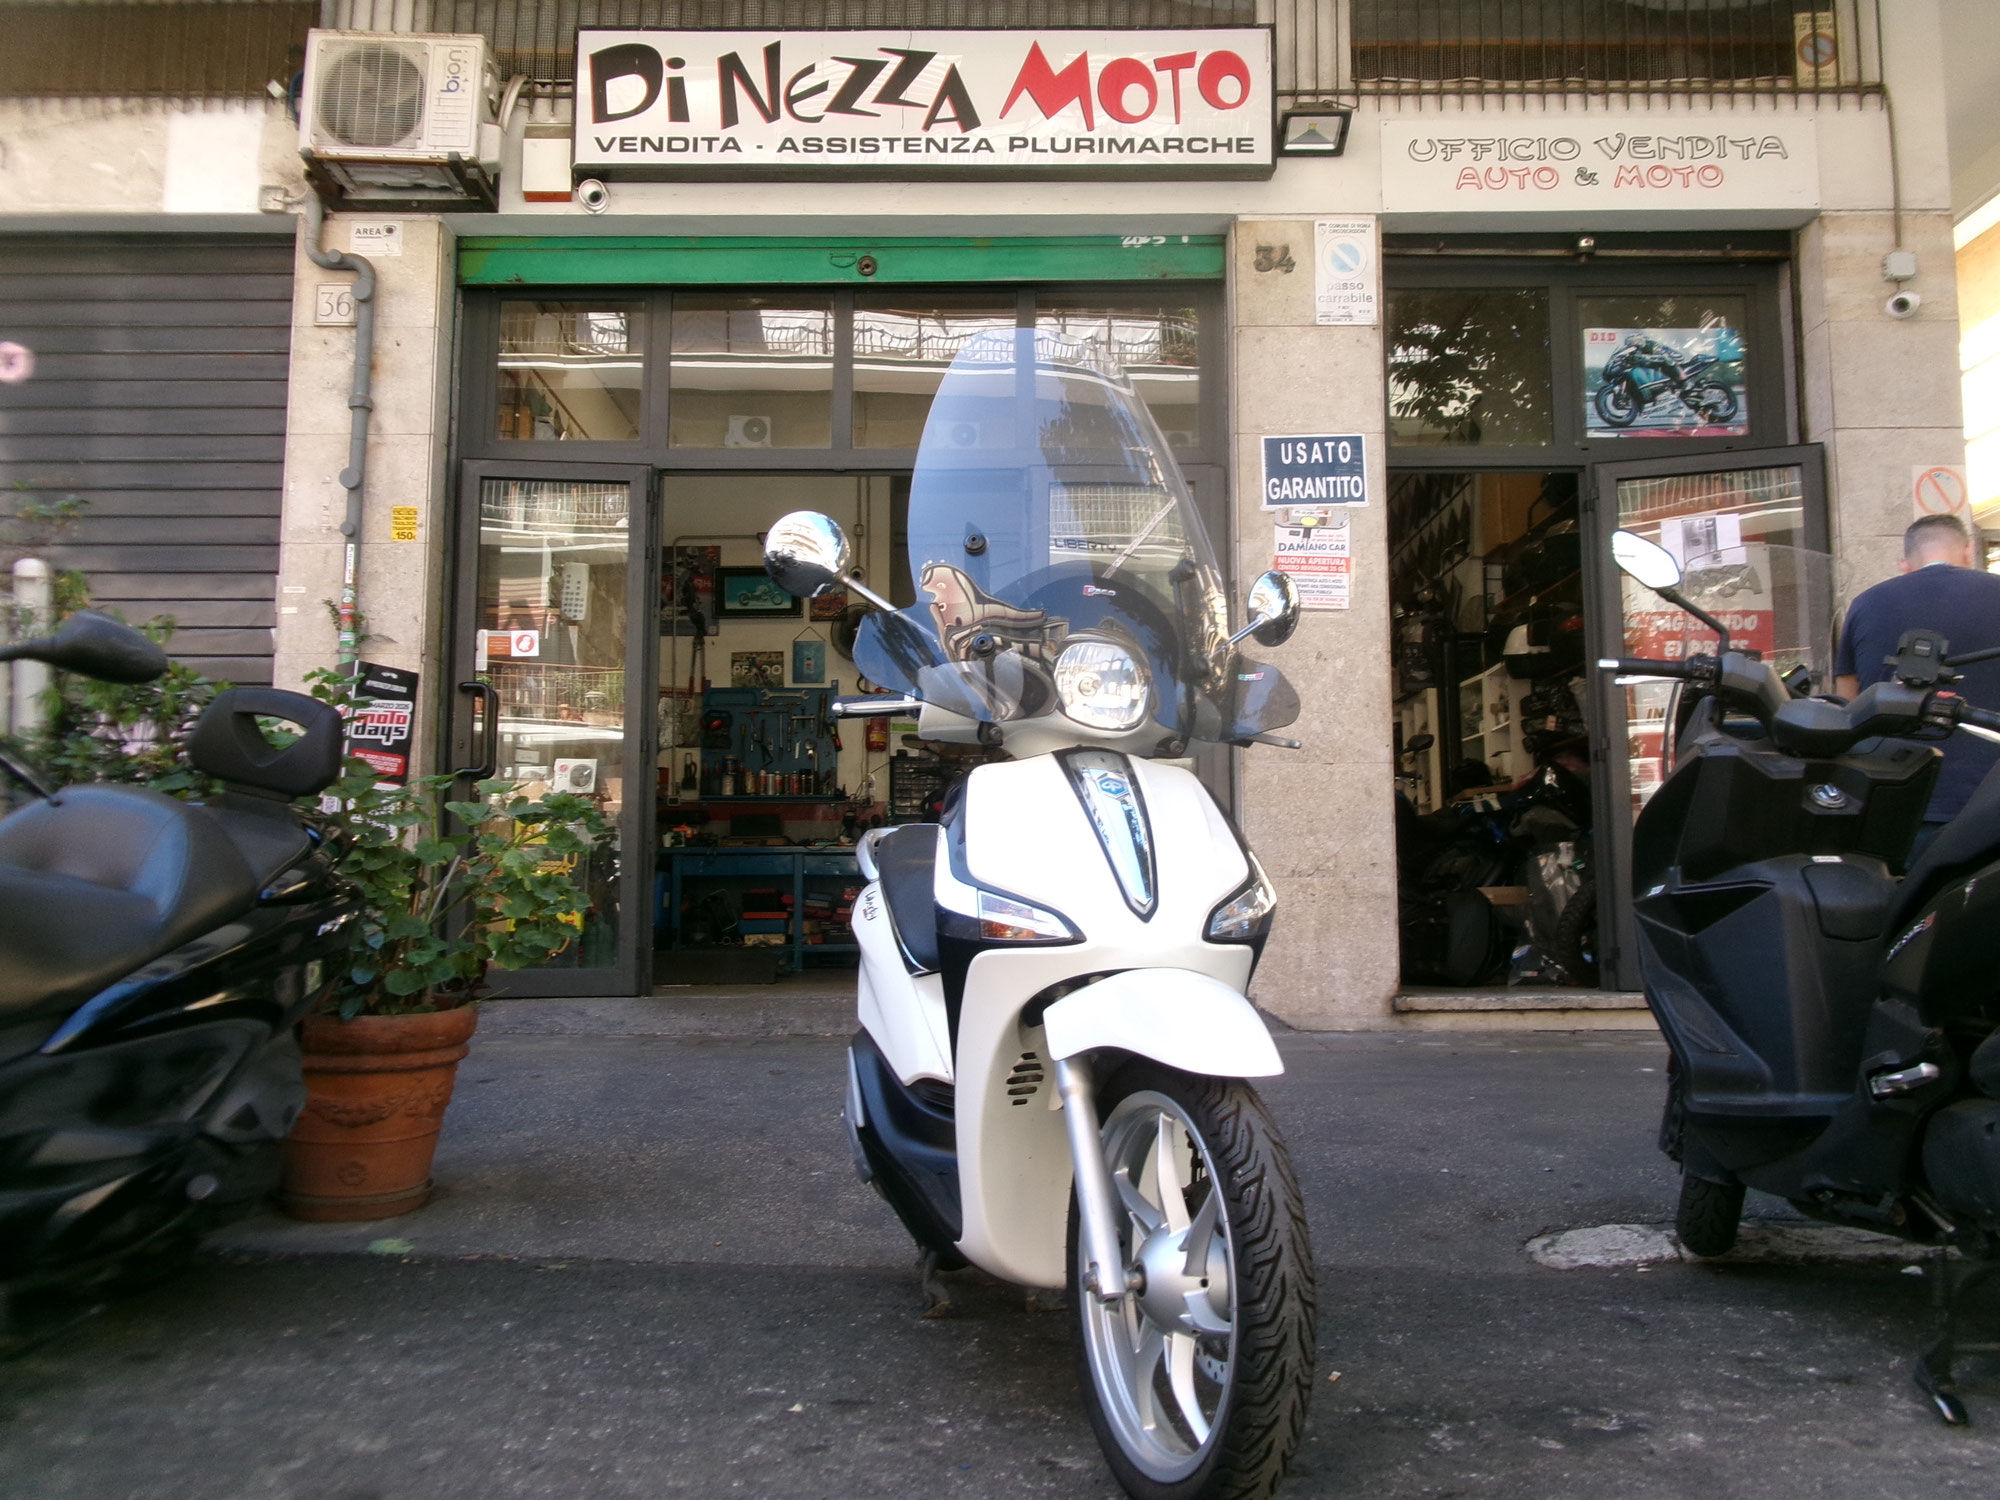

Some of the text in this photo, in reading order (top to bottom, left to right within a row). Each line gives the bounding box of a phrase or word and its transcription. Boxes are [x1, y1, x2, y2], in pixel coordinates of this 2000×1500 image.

[589, 42, 690, 124] Di
[999, 39, 1251, 131] MOTO
[594, 136, 742, 153] VENDITA
[776, 136, 995, 153] ASSISTENZA
[1008, 136, 1255, 153] PLURIMARCHE
[1408, 133, 1788, 162] UFFICIO VENDITA
[1455, 164, 1724, 190] AUTO & MOTO
[355, 227, 382, 236] AREA
[1253, 244, 1296, 273] 34
[1318, 292, 1373, 303] carrabile
[1327, 282, 1364, 293] passo
[319, 291, 355, 317] 36
[1280, 441, 1351, 464] USATO
[1267, 475, 1363, 500] GARANTITO
[1054, 538, 1117, 552] LIBERTY
[1278, 543, 1346, 552] DAMIANO CAR
[354, 723, 405, 742] days
